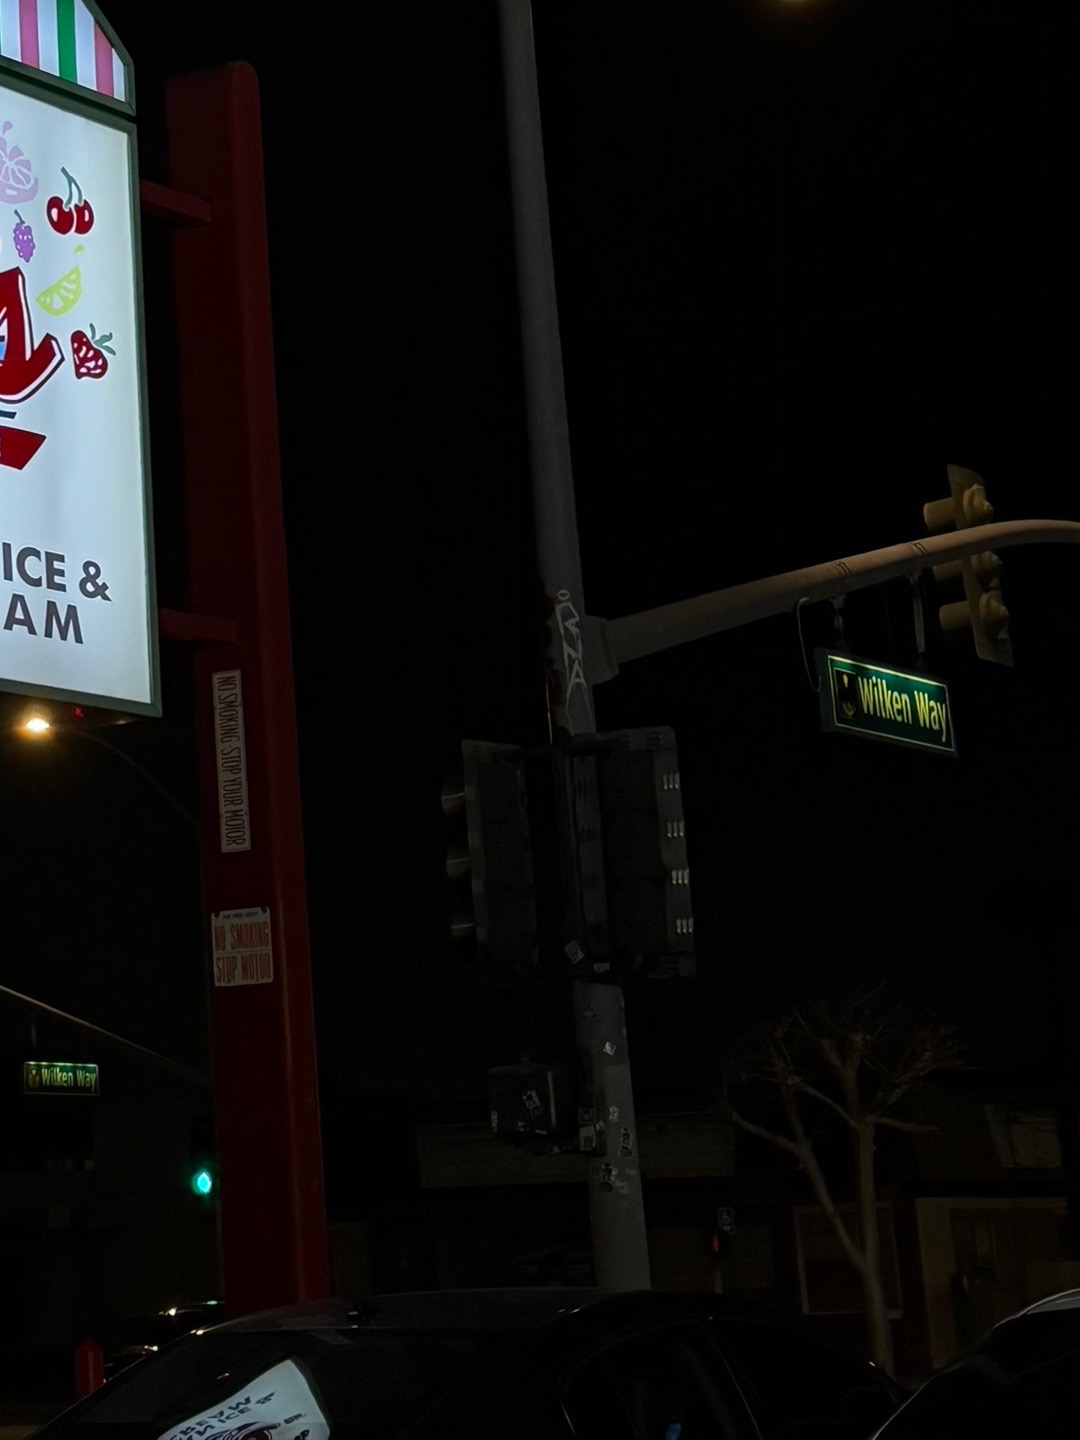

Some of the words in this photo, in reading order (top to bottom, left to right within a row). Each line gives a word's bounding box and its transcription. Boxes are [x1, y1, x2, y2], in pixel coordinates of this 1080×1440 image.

[2, 541, 67, 593] ICE
[79, 559, 112, 602] &
[217, 674, 237, 692] NO
[217, 693, 240, 743] SMOKING
[857, 675, 913, 725] Wilken
[913, 689, 947, 744] Way
[222, 778, 244, 806] YOUR
[224, 809, 246, 847] MOTOR
[41, 1067, 74, 1087] Wilken
[76, 1069, 97, 1093] Way
